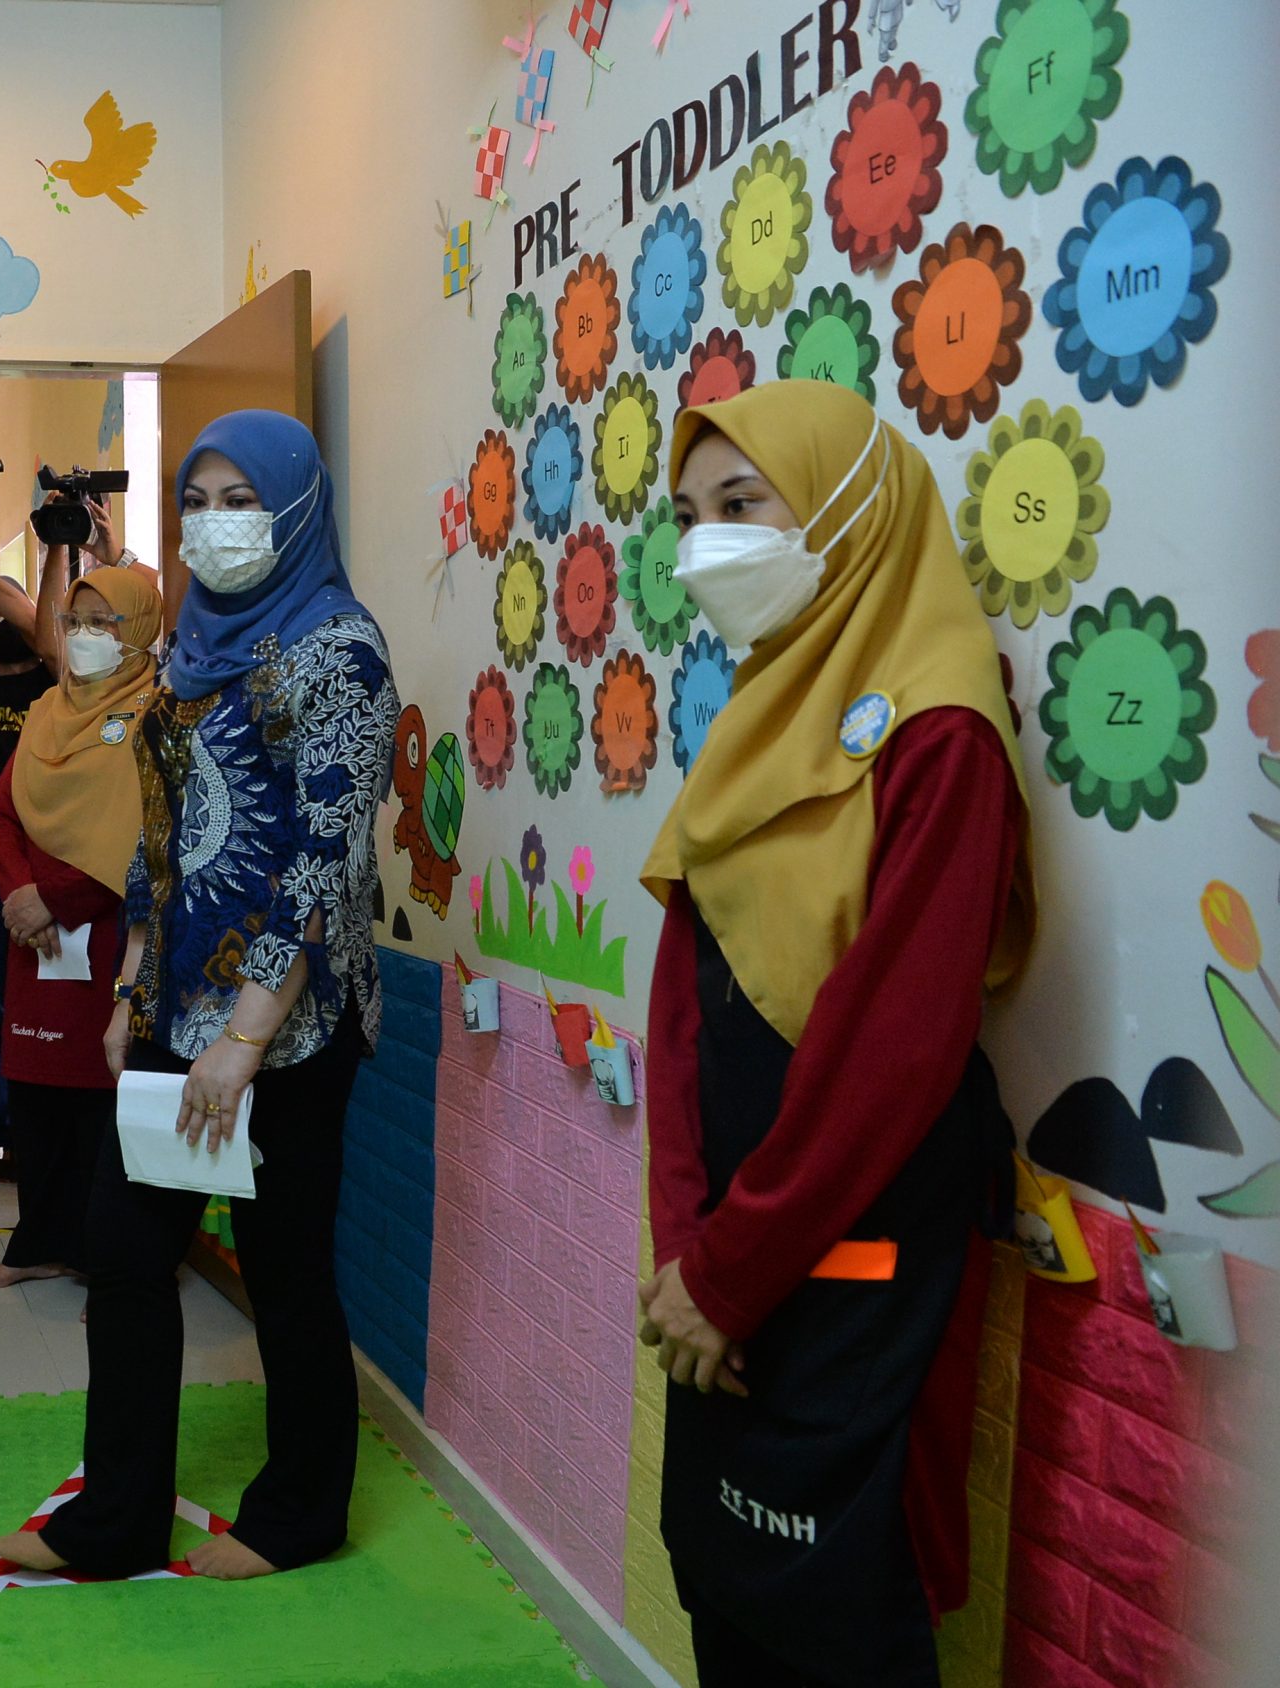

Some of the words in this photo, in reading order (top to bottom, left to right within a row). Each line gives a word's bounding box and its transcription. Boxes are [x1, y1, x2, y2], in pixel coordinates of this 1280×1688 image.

[1028, 50, 1054, 94] Ff
[513, 179, 582, 289] PRE
[612, 0, 862, 228] TODDLER
[868, 153, 898, 185] Ee
[752, 211, 772, 245] Dd
[655, 274, 672, 296] Cc
[1107, 265, 1159, 302] Mm
[579, 314, 592, 337] Bb
[513, 352, 524, 370] Aa
[619, 437, 628, 459] Ii
[545, 460, 558, 481] Hh
[484, 482, 496, 502] Gg
[1014, 492, 1045, 523] Ss
[656, 562, 672, 587] Pp
[514, 594, 525, 612] Nn
[578, 583, 593, 603] Oo
[1107, 692, 1142, 725] Zz
[485, 719, 494, 736] Tt
[616, 712, 631, 733] Vv
[36, 1027, 64, 1041] League
